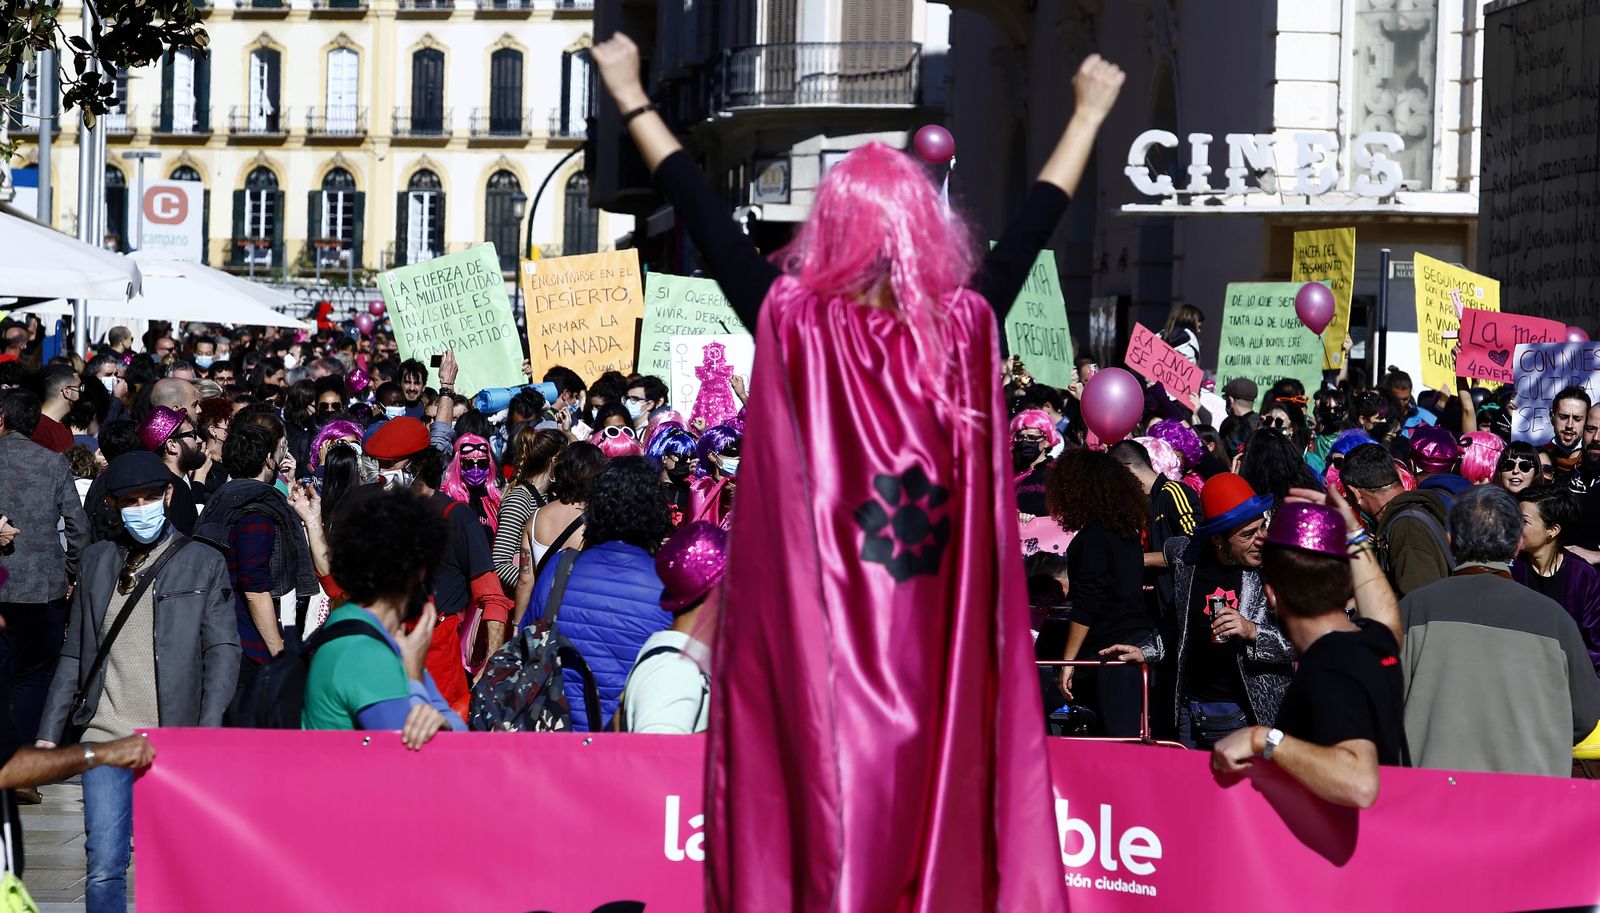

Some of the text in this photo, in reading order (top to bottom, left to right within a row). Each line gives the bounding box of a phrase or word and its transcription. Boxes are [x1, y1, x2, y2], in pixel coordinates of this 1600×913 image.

[1124, 129, 1405, 197] CINES
[1299, 243, 1337, 259] HACER DEL
[600, 269, 614, 279] EN
[619, 267, 633, 277] EL
[1299, 260, 1343, 274] PENSAMIENTO
[390, 259, 484, 297] LA FUERZA DE
[395, 271, 502, 313] LA MULTIPLICIDAD
[655, 286, 670, 299] SI
[1231, 294, 1242, 307] DE
[1247, 295, 1256, 307] LO
[400, 290, 491, 329] INVISIBLE ES
[1024, 301, 1047, 319] FOR
[1425, 312, 1432, 324] A
[405, 309, 495, 347] PARTIR DE LO
[541, 314, 619, 336] ARMAR LA
[1229, 315, 1250, 326] TRATA
[1267, 317, 1277, 328] DE
[1469, 311, 1503, 349] La
[412, 323, 511, 360] COMPARTIDO
[1014, 322, 1070, 366] PRESIDENT
[1228, 336, 1246, 348] VIDA
[1427, 328, 1448, 349] BIEN
[1129, 346, 1192, 395] SE QUEDA
[1519, 349, 1556, 372] CON
[1094, 876, 1157, 897] ciudadana
